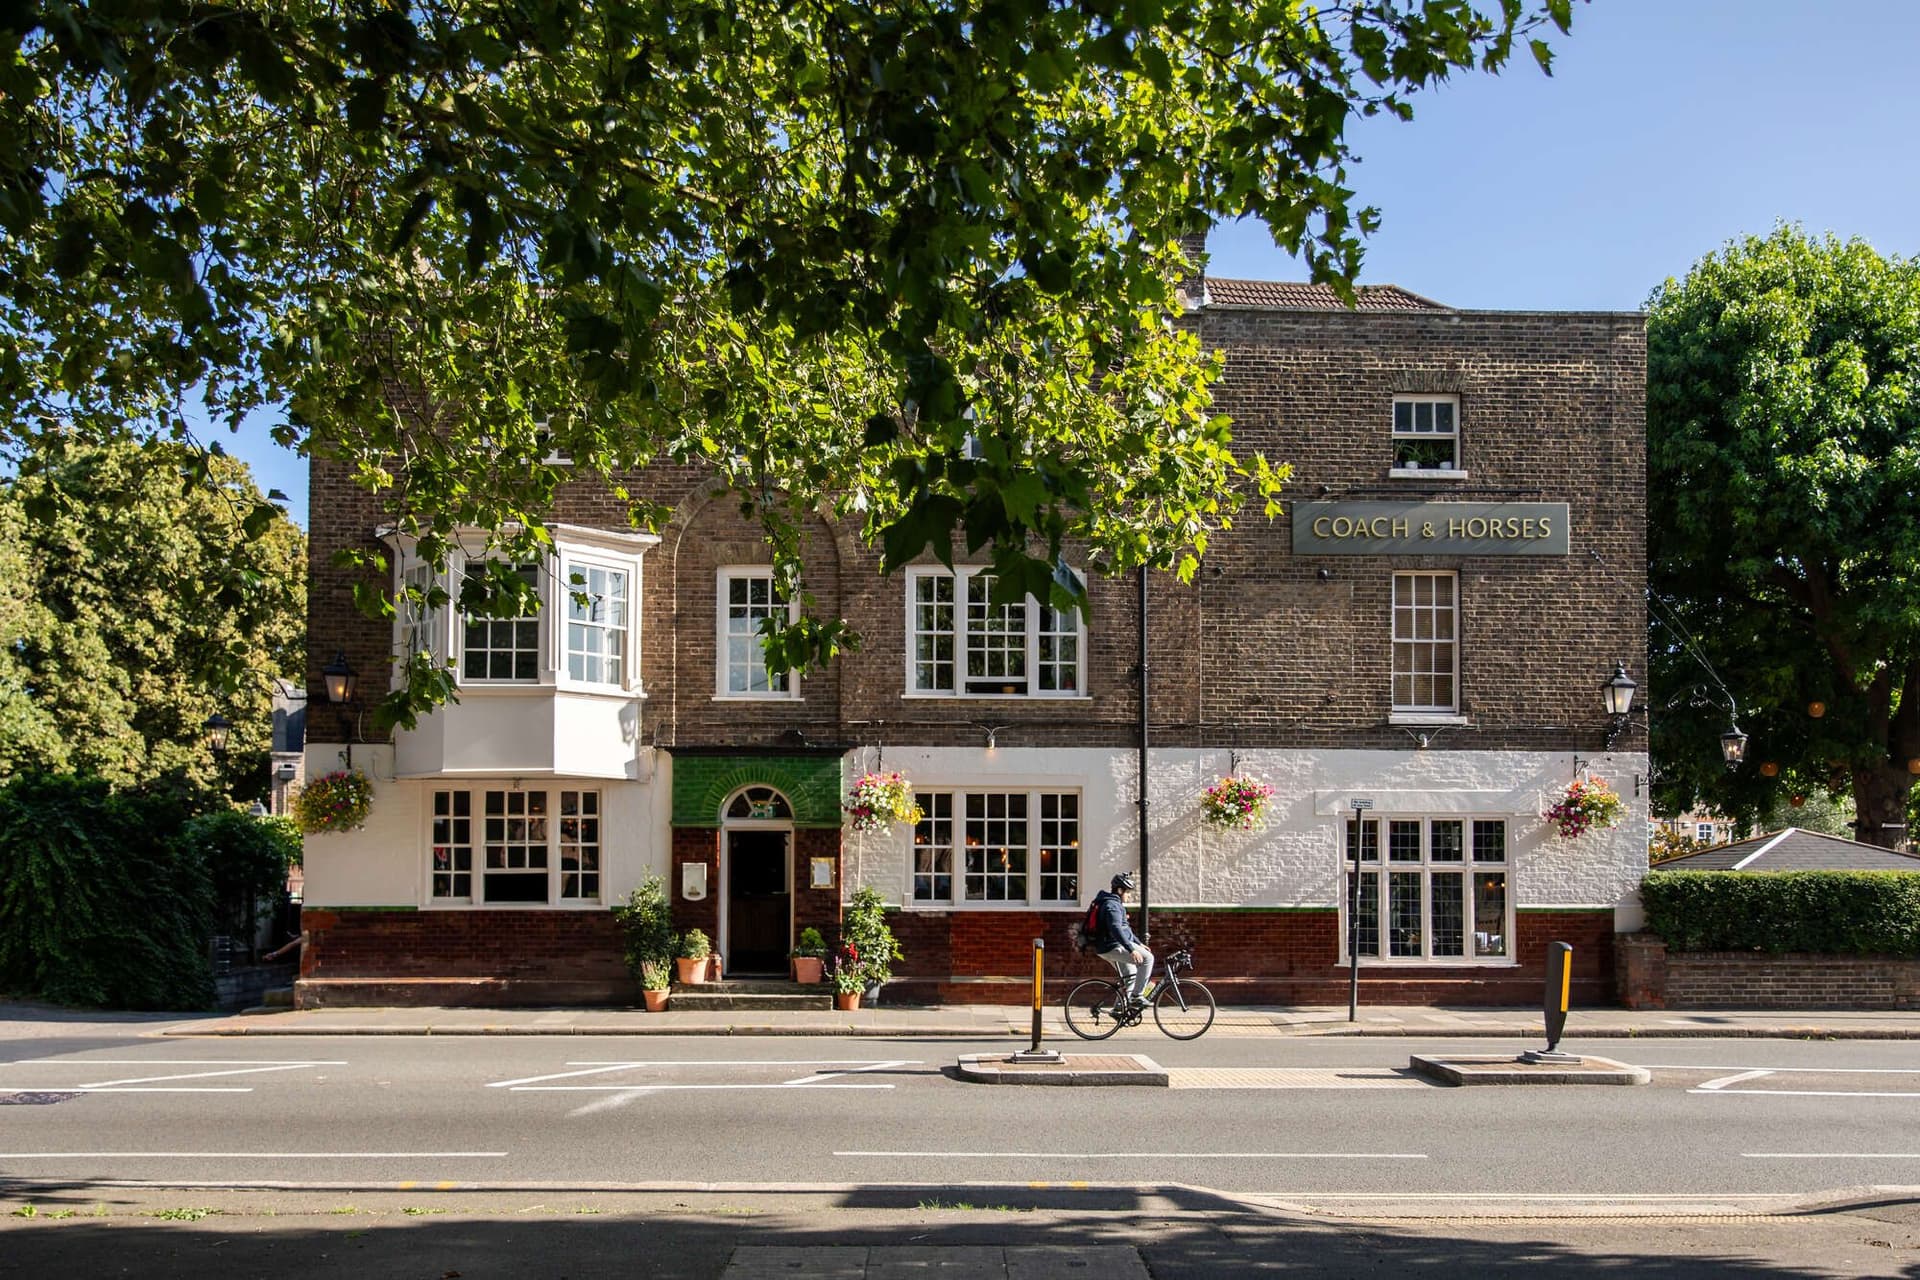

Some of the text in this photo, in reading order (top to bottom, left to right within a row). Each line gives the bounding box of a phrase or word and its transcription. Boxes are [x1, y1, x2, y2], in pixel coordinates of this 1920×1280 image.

[1312, 516, 1552, 539] COACH & HORSES
